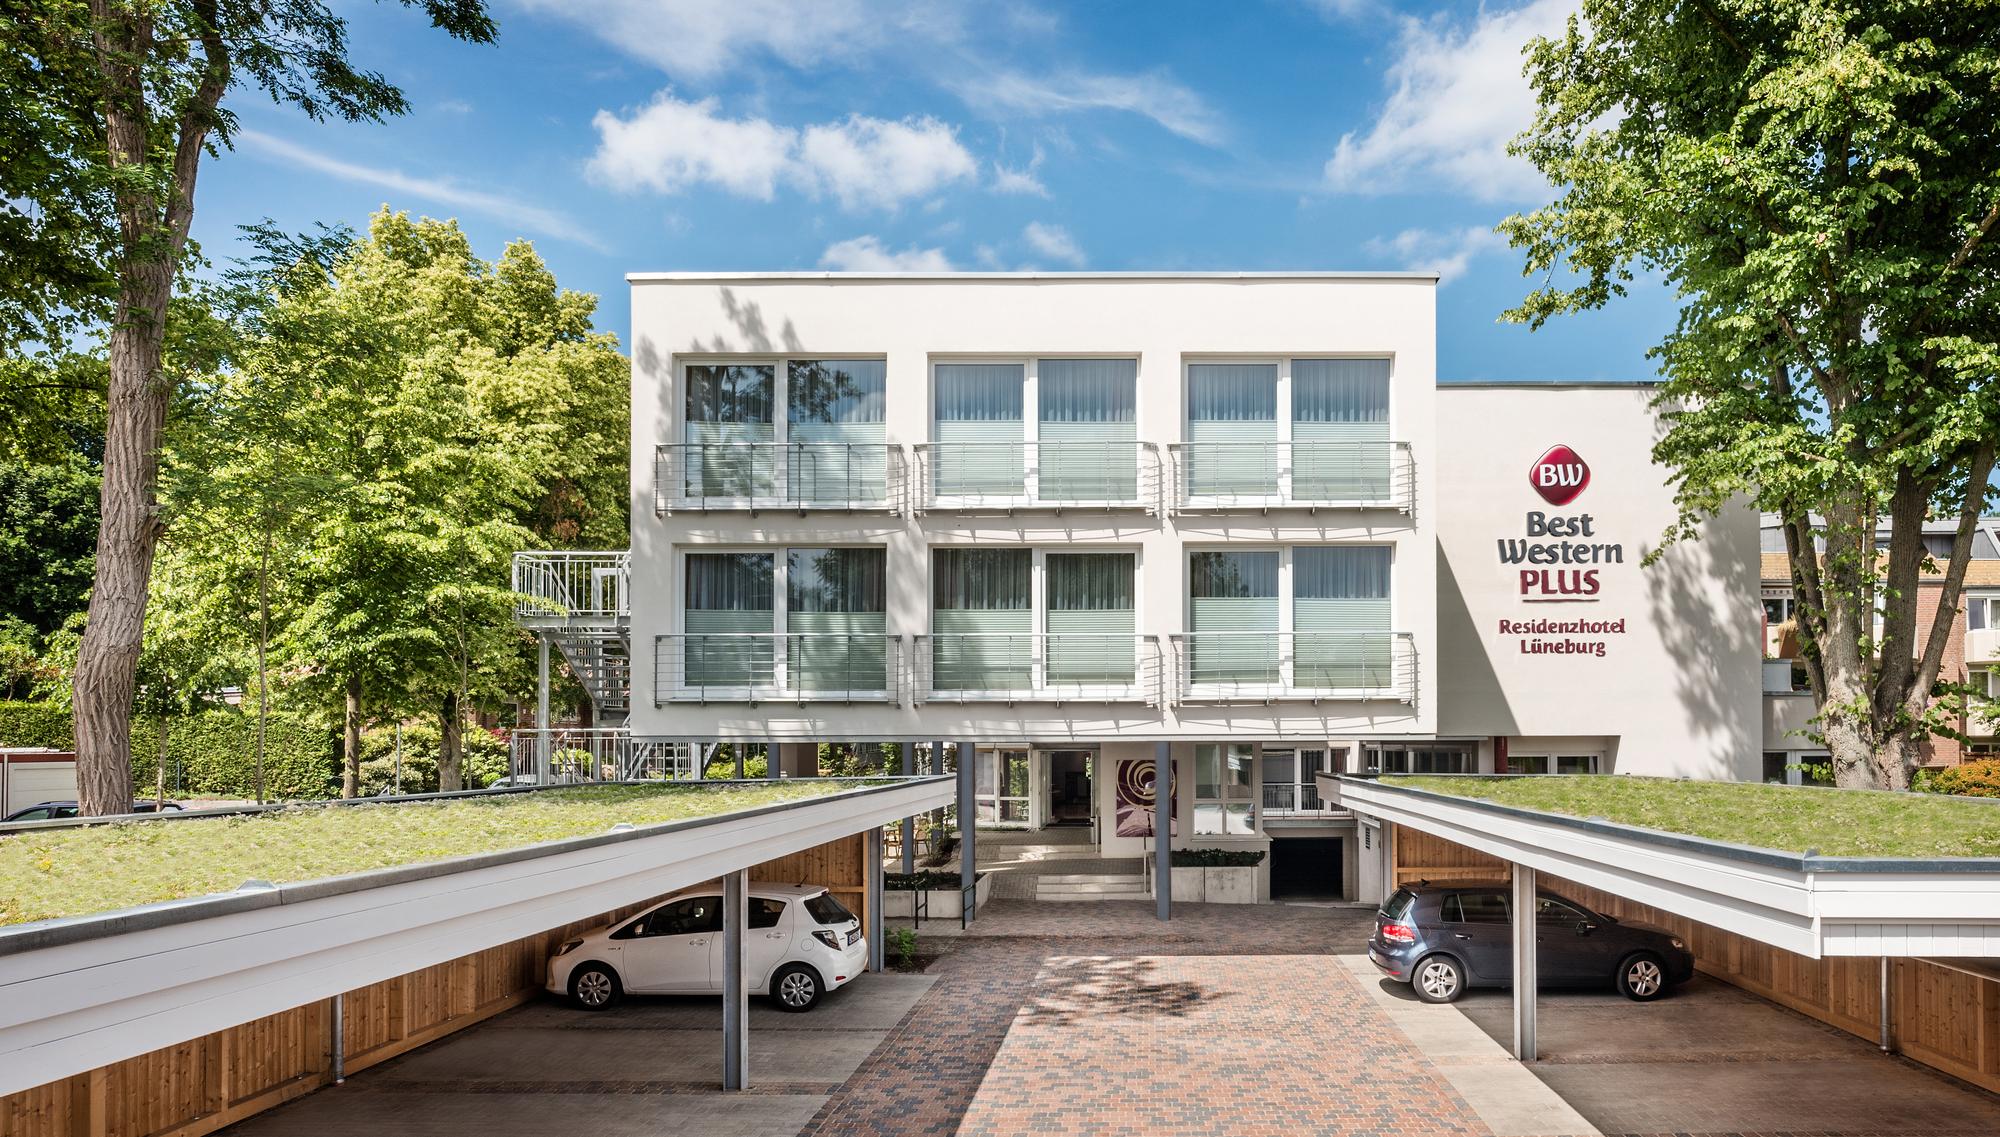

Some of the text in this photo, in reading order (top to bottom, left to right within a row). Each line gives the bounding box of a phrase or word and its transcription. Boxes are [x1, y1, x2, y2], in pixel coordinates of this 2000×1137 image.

[1539, 464, 1583, 487] BW
[1527, 511, 1595, 537] Best
[1497, 538, 1624, 564] Western
[1520, 569, 1600, 595] PLUS
[1499, 618, 1626, 635] Residenzhotel
[1521, 638, 1606, 657] Lüneburg
